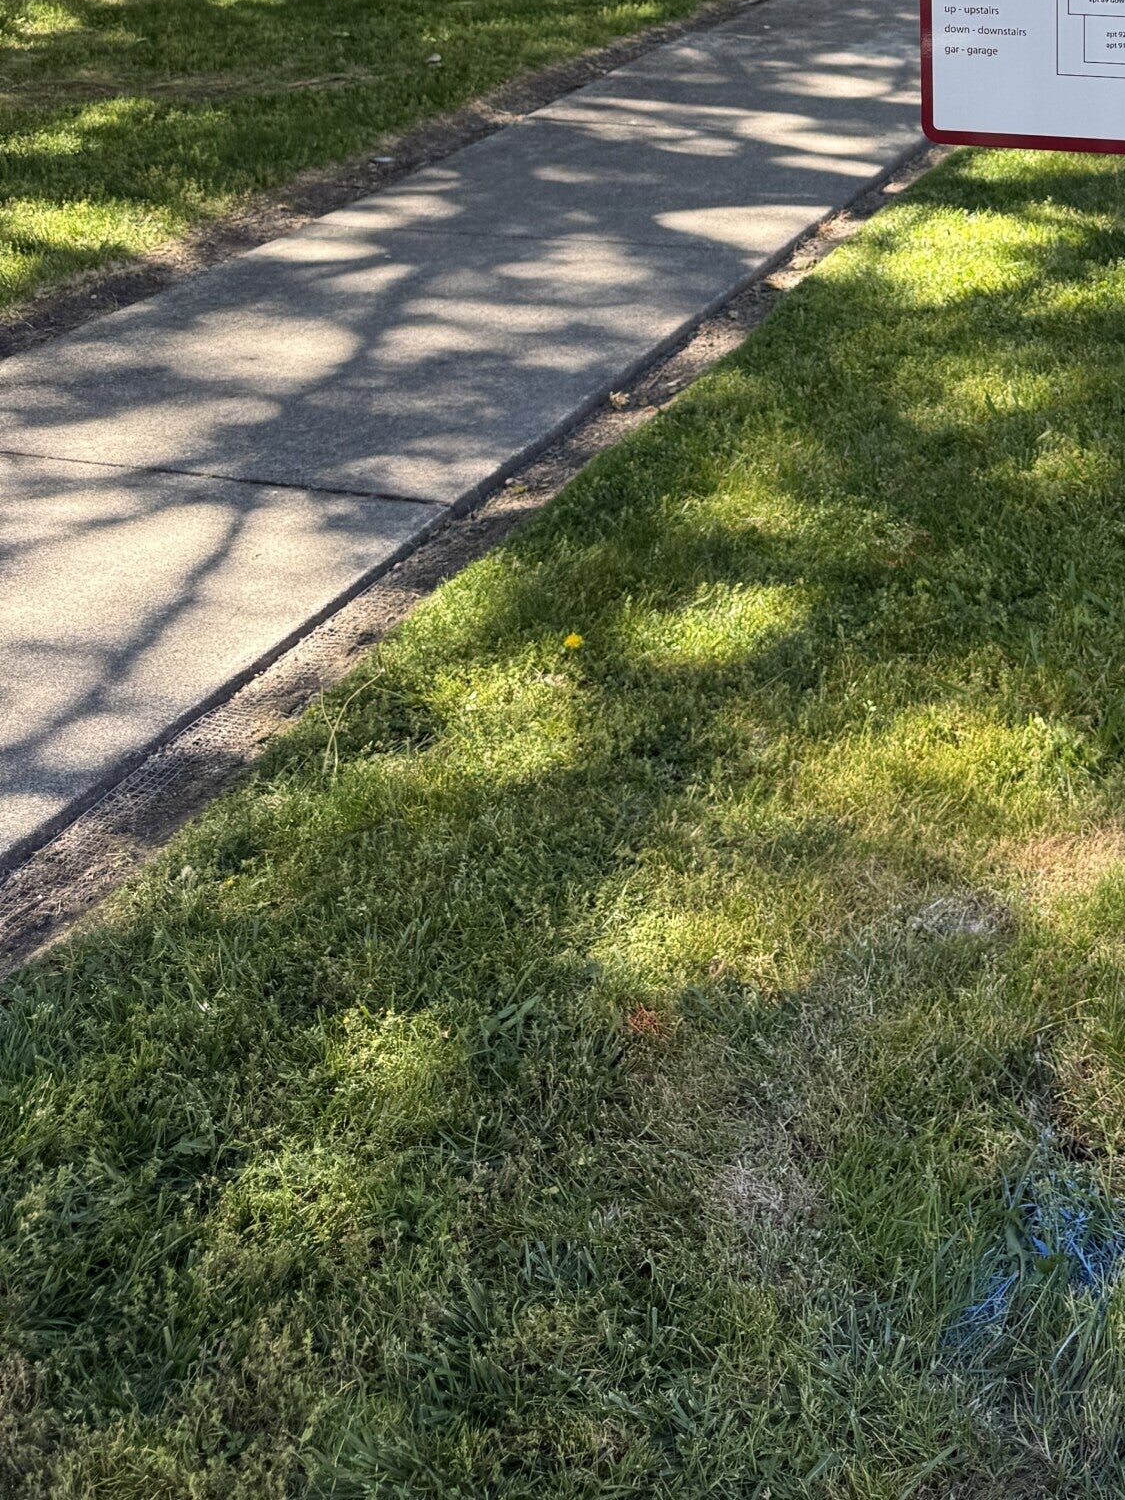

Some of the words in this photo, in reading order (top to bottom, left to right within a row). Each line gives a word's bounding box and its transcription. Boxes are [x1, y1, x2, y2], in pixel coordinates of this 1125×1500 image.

[944, 5, 957, 16] up
[964, 5, 1000, 17] upstairs
[944, 25, 971, 34] down
[978, 25, 1027, 37] downstairs
[944, 45, 961, 57] gar
[967, 46, 998, 57] garage
